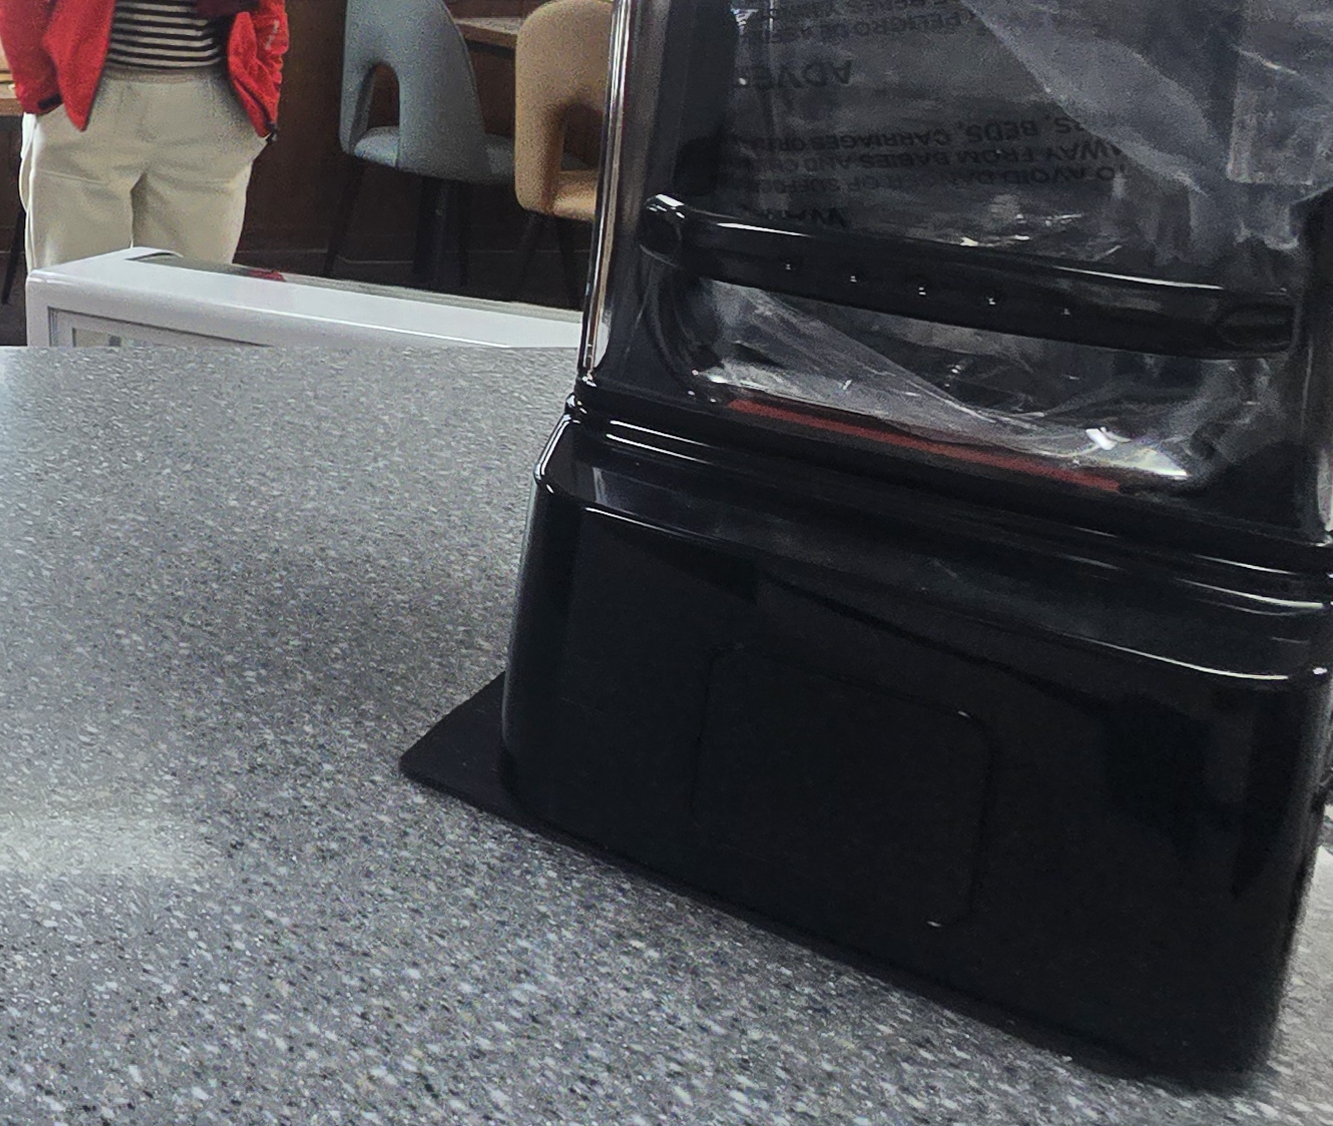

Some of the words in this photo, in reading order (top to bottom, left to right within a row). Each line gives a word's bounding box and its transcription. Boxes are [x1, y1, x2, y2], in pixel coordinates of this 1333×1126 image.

[956, 119, 1039, 143] BEDS,
[858, 152, 950, 169] BABIES
[956, 146, 1035, 164] FROM
